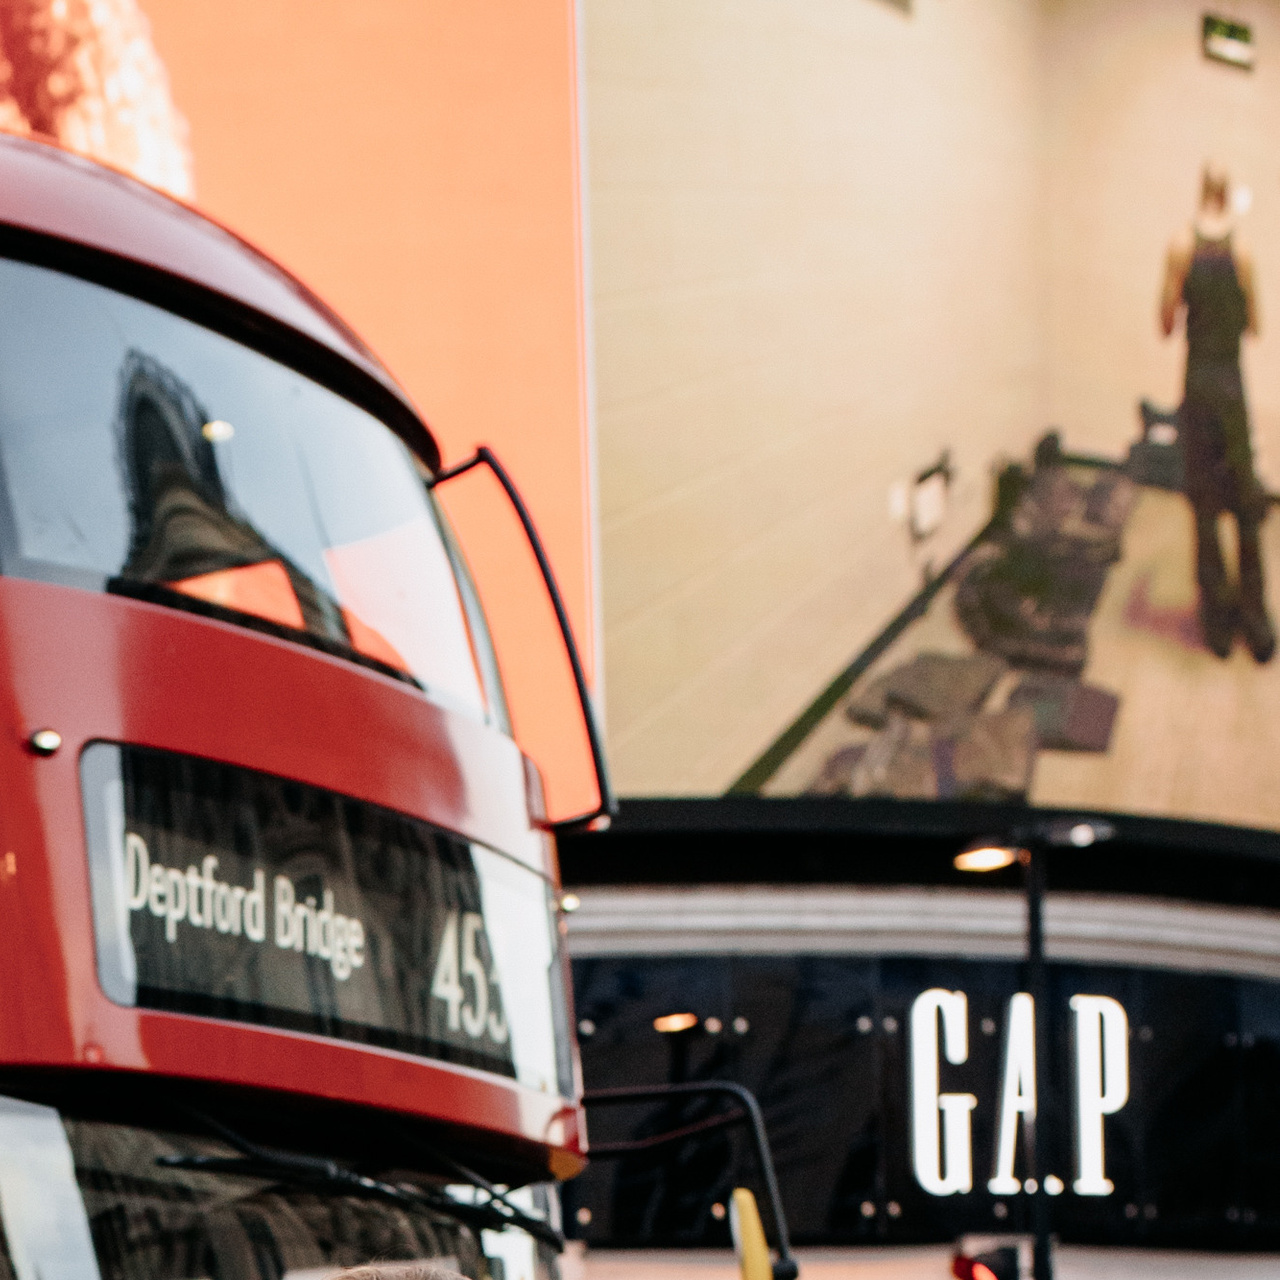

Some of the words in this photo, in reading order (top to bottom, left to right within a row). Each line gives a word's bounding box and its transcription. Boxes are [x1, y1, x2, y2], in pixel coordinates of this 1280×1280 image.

[125, 832, 266, 942] Deptford
[274, 874, 365, 981] Bridge
[910, 987, 1130, 1197] GAP
